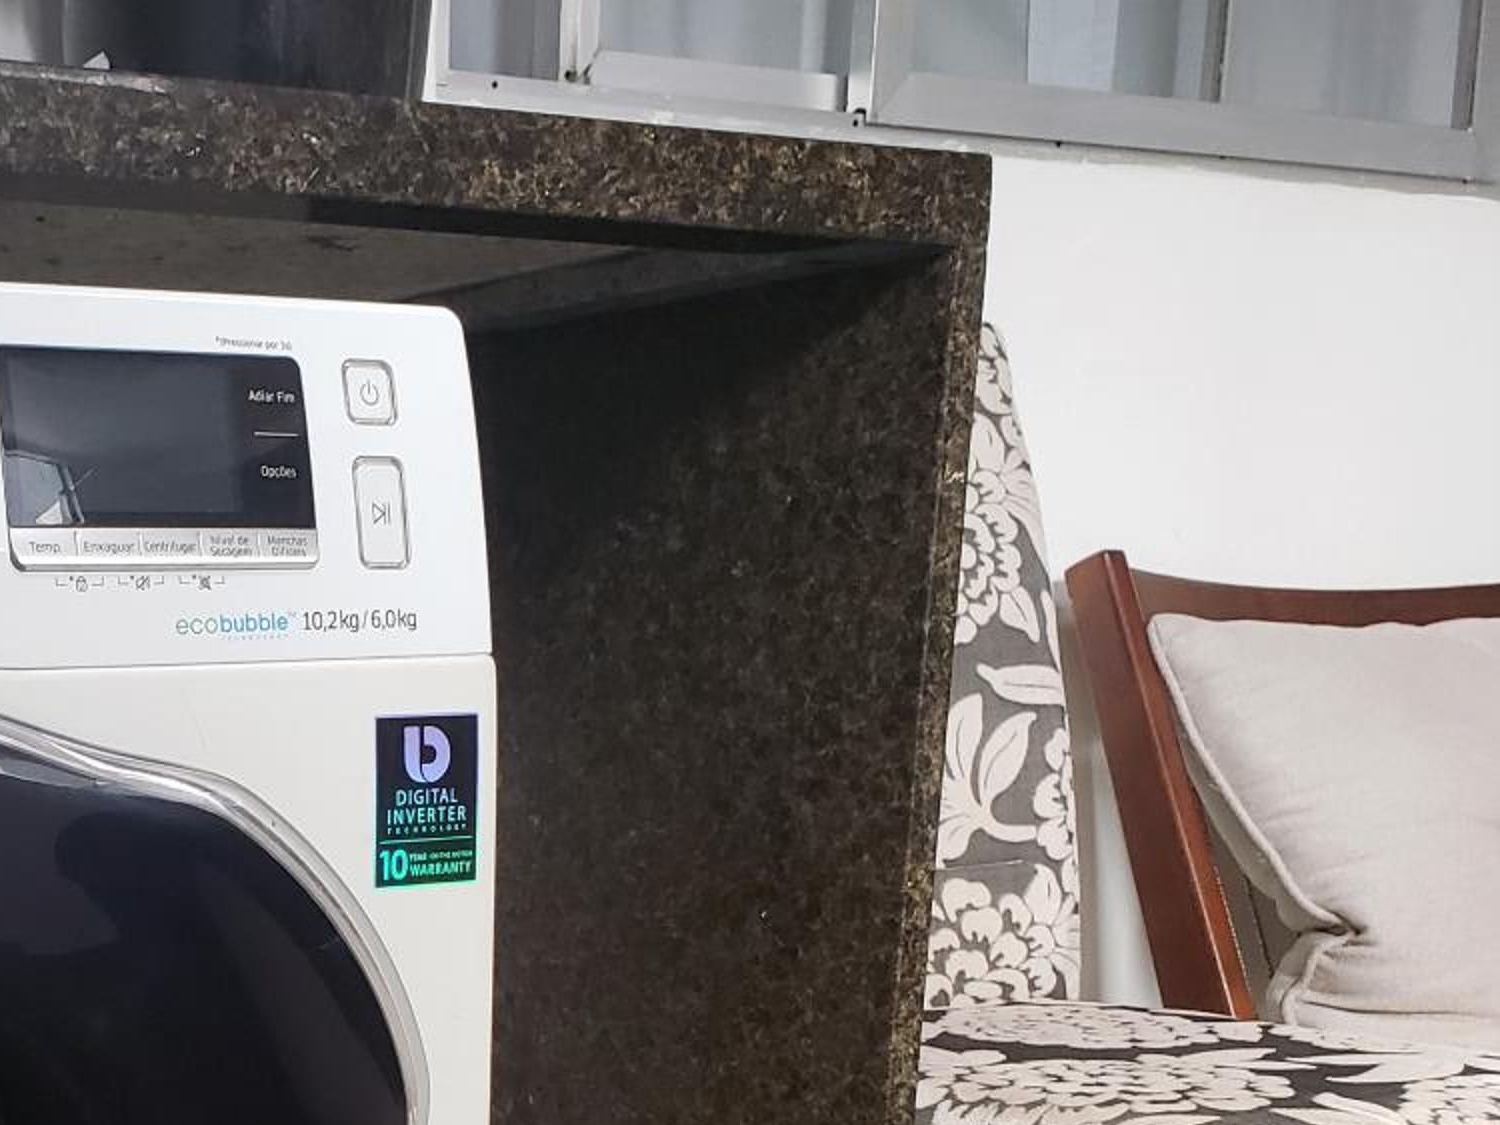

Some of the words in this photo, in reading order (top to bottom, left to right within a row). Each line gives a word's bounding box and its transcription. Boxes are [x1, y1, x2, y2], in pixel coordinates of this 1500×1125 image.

[175, 612, 289, 635] ecobubble
[396, 788, 458, 806] DIGITAL
[388, 805, 467, 825] INVERTER
[380, 849, 409, 881] 10
[410, 861, 472, 877] WARRANTY
